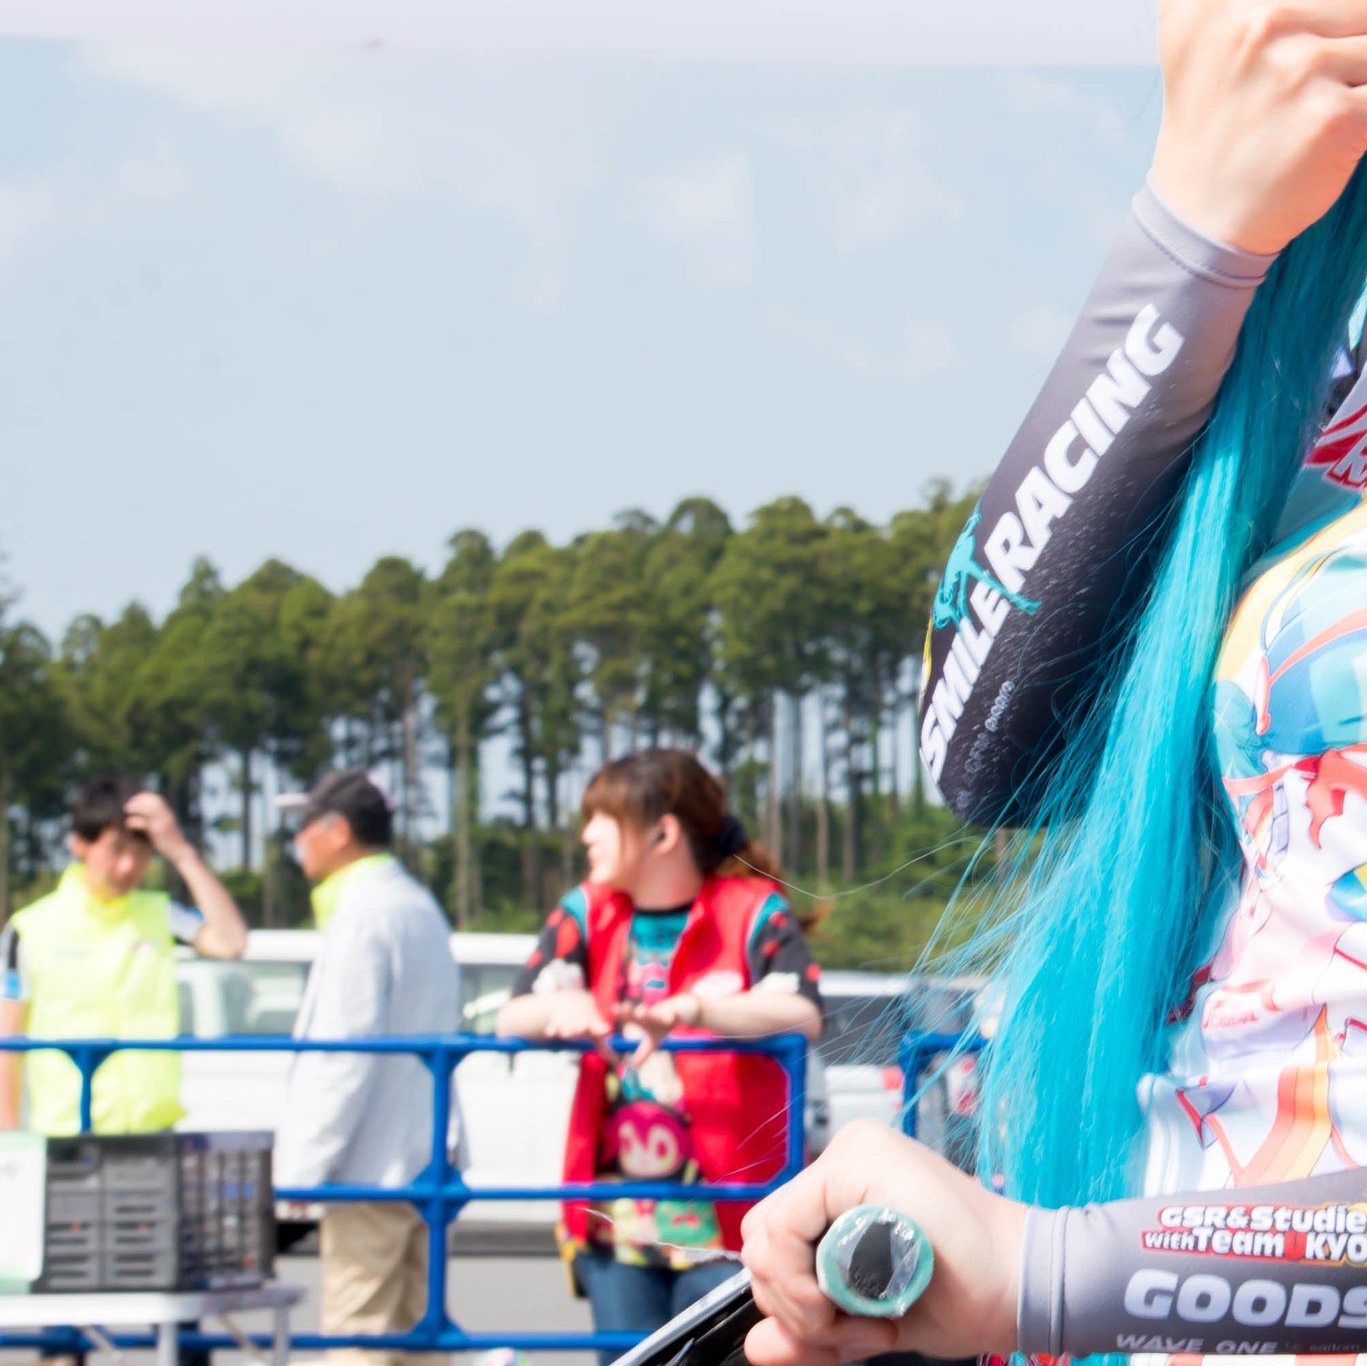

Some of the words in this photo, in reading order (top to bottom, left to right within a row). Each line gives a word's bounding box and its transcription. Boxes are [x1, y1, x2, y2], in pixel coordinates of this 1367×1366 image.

[919, 580, 1006, 784] SMILE
[984, 303, 1185, 589] RACING
[1115, 1333, 1204, 1352] WAVE
[1215, 1340, 1279, 1355] ONE
